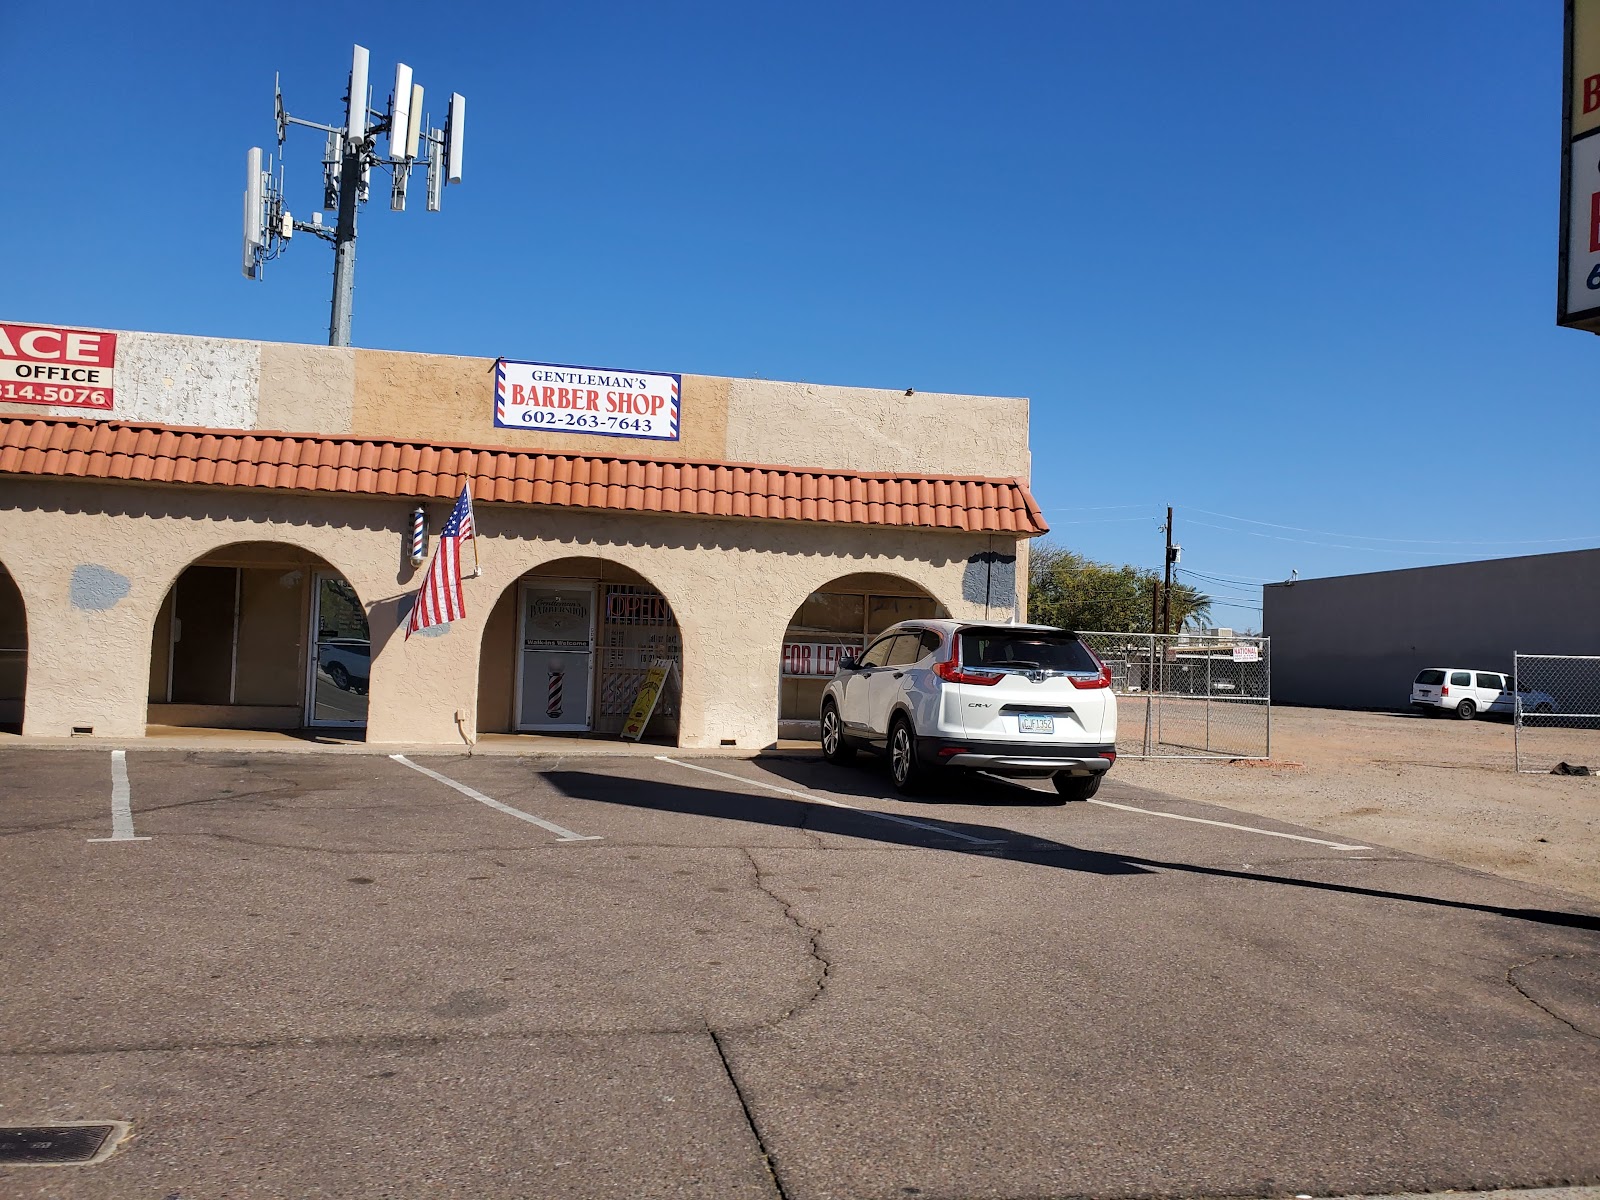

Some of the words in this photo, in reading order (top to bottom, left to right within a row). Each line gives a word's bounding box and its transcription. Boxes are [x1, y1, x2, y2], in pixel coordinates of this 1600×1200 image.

[15, 364, 100, 383] OFFICE
[531, 369, 647, 390] GENTLEMAN'S
[0, 383, 106, 405] 14.5076
[511, 383, 600, 412] BARBER
[605, 391, 665, 416] SHOP
[521, 409, 652, 432] 602-263-7643
[782, 644, 812, 674] FOR
[1234, 647, 1257, 655] NATIONAL
